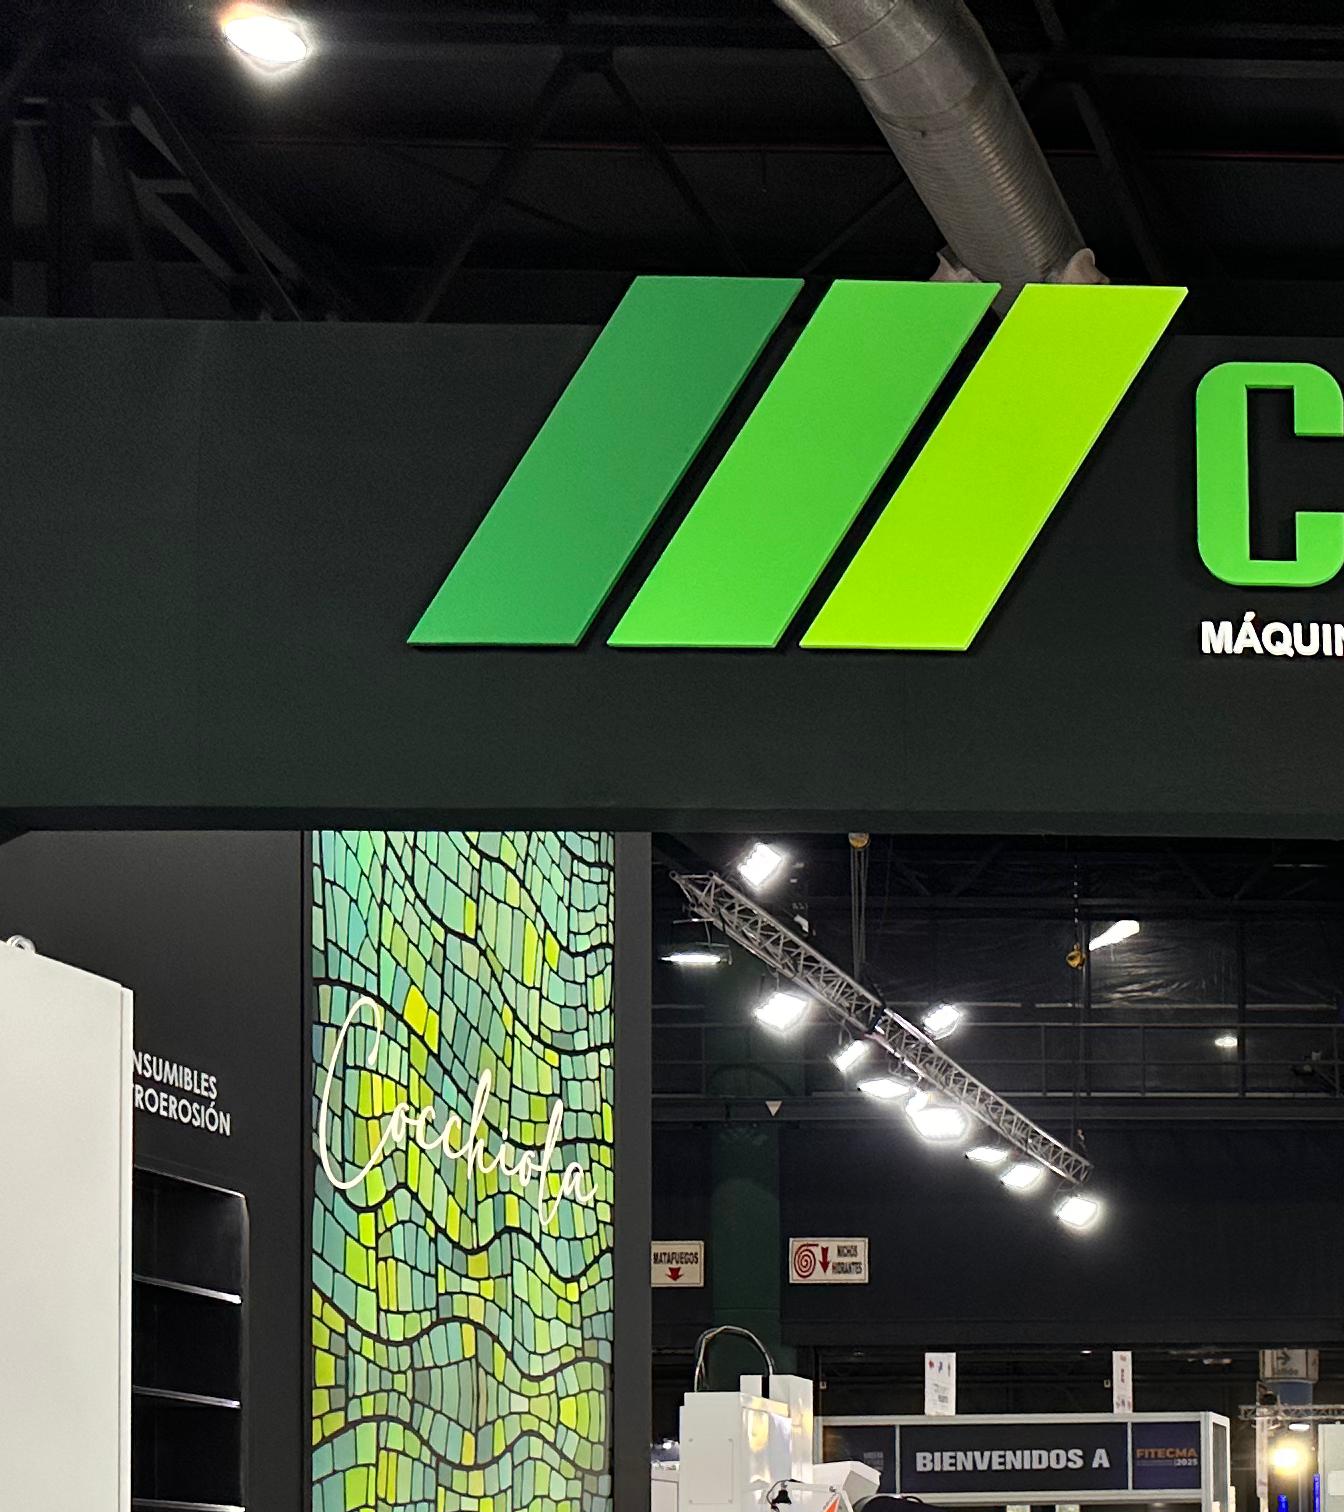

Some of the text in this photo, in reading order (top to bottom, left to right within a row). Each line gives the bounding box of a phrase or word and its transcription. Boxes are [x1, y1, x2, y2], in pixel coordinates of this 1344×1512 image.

[132, 1083, 231, 1137] ROEROSIÓN
[319, 996, 599, 1226] Cocchiola
[653, 1251, 699, 1265] MATAFUEGOS
[915, 1448, 1110, 1472] BIENVENIDOS A
[1136, 1448, 1198, 1458] FITECMA
